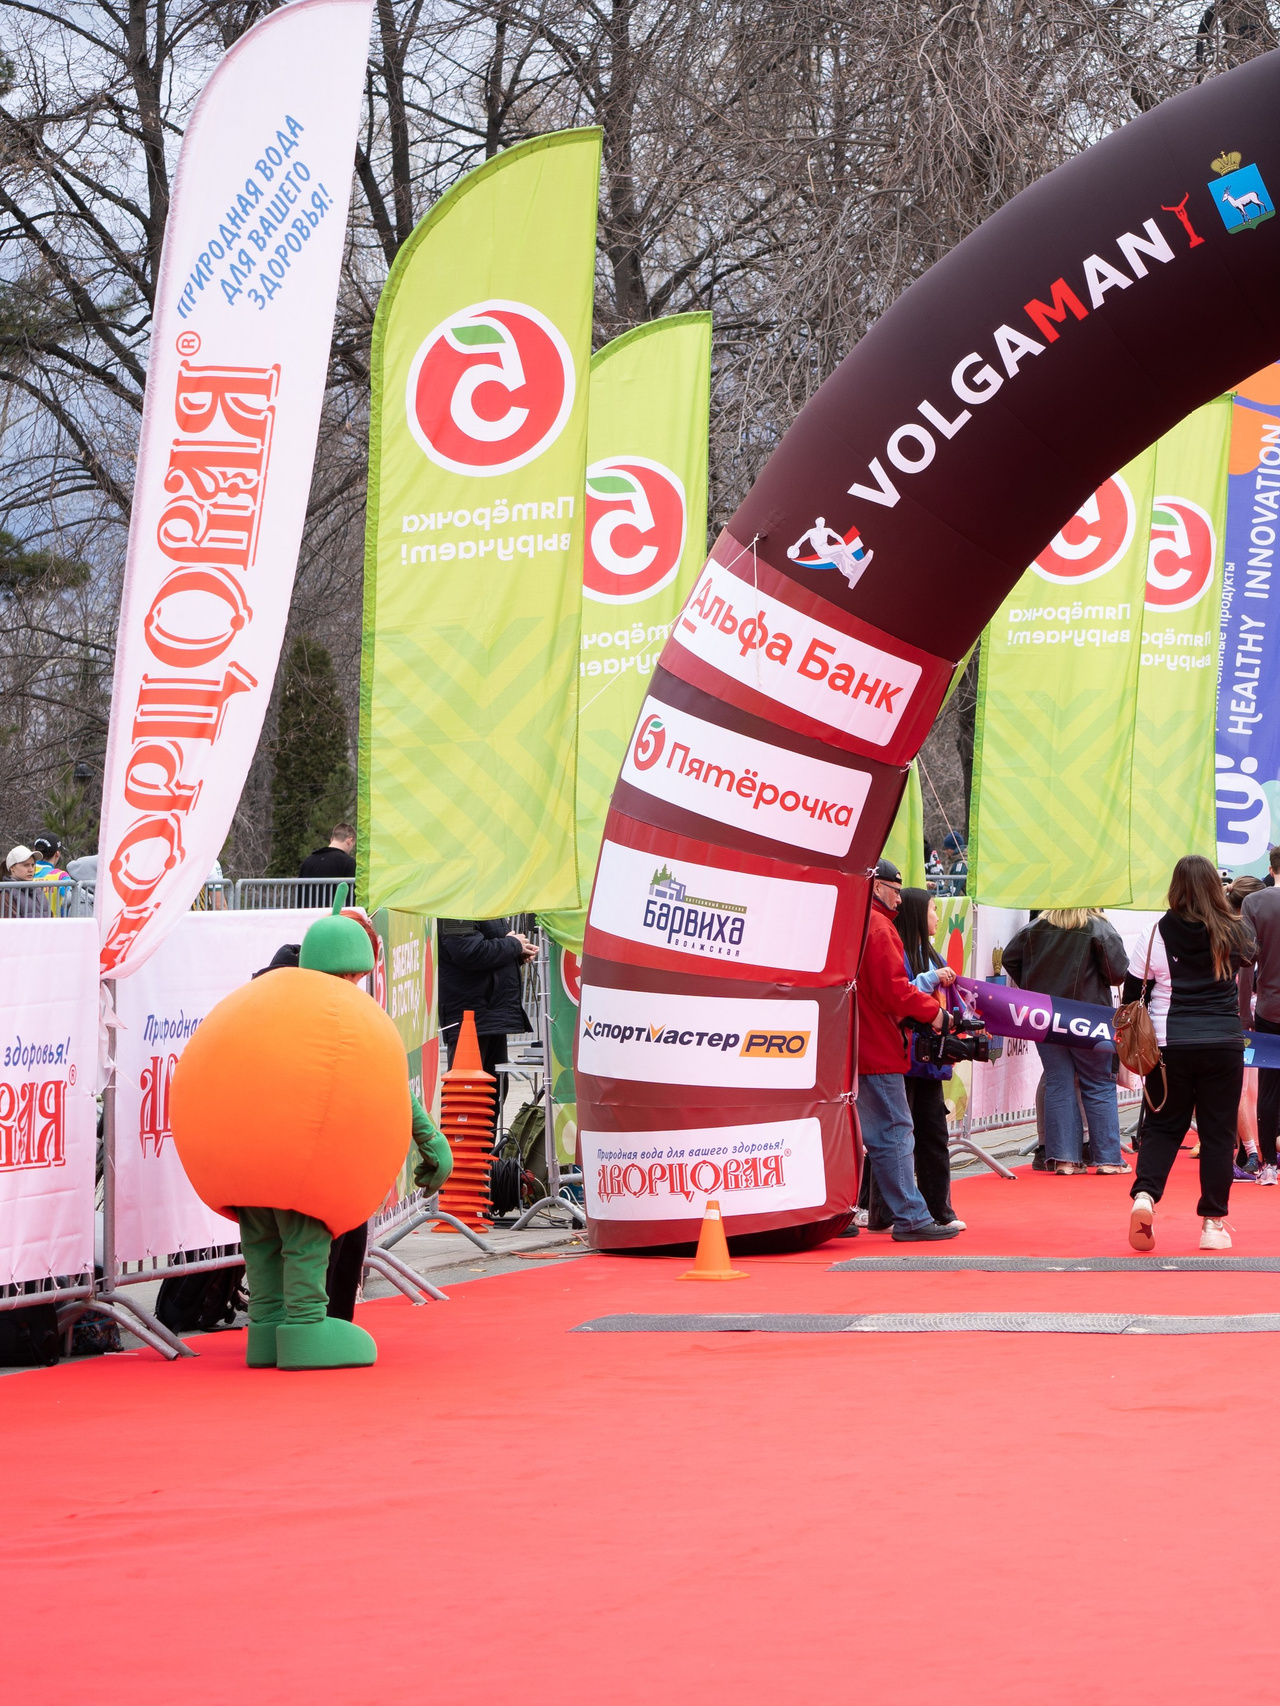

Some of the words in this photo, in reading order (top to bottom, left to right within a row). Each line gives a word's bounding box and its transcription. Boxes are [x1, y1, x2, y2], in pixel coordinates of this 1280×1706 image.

[176, 177, 265, 320] ПРИРОДНАЯ
[254, 114, 305, 182] ВОДА
[220, 248, 257, 306] ДЛЯ
[247, 160, 311, 252] ВАШЕГО
[246, 182, 334, 311] ЗДОРОВЬЯ!
[847, 217, 1176, 509] VOLGAMAN
[683, 577, 793, 666] Альфа
[797, 637, 904, 714] Банк
[1228, 614, 1266, 735] HEALTHY
[665, 741, 854, 827] Пятёрочка
[4, 1035, 71, 1073] здоровья!
[745, 1033, 806, 1054] PRO
[1008, 1003, 1111, 1040] VOLGA
[597, 1148, 638, 1161] Природная
[641, 1147, 664, 1160] вода
[666, 1147, 685, 1158] для
[688, 1145, 729, 1157] вашего
[732, 1139, 785, 1155] здоровья!
[598, 1154, 787, 1203] ДВОРЦОВАЯ
